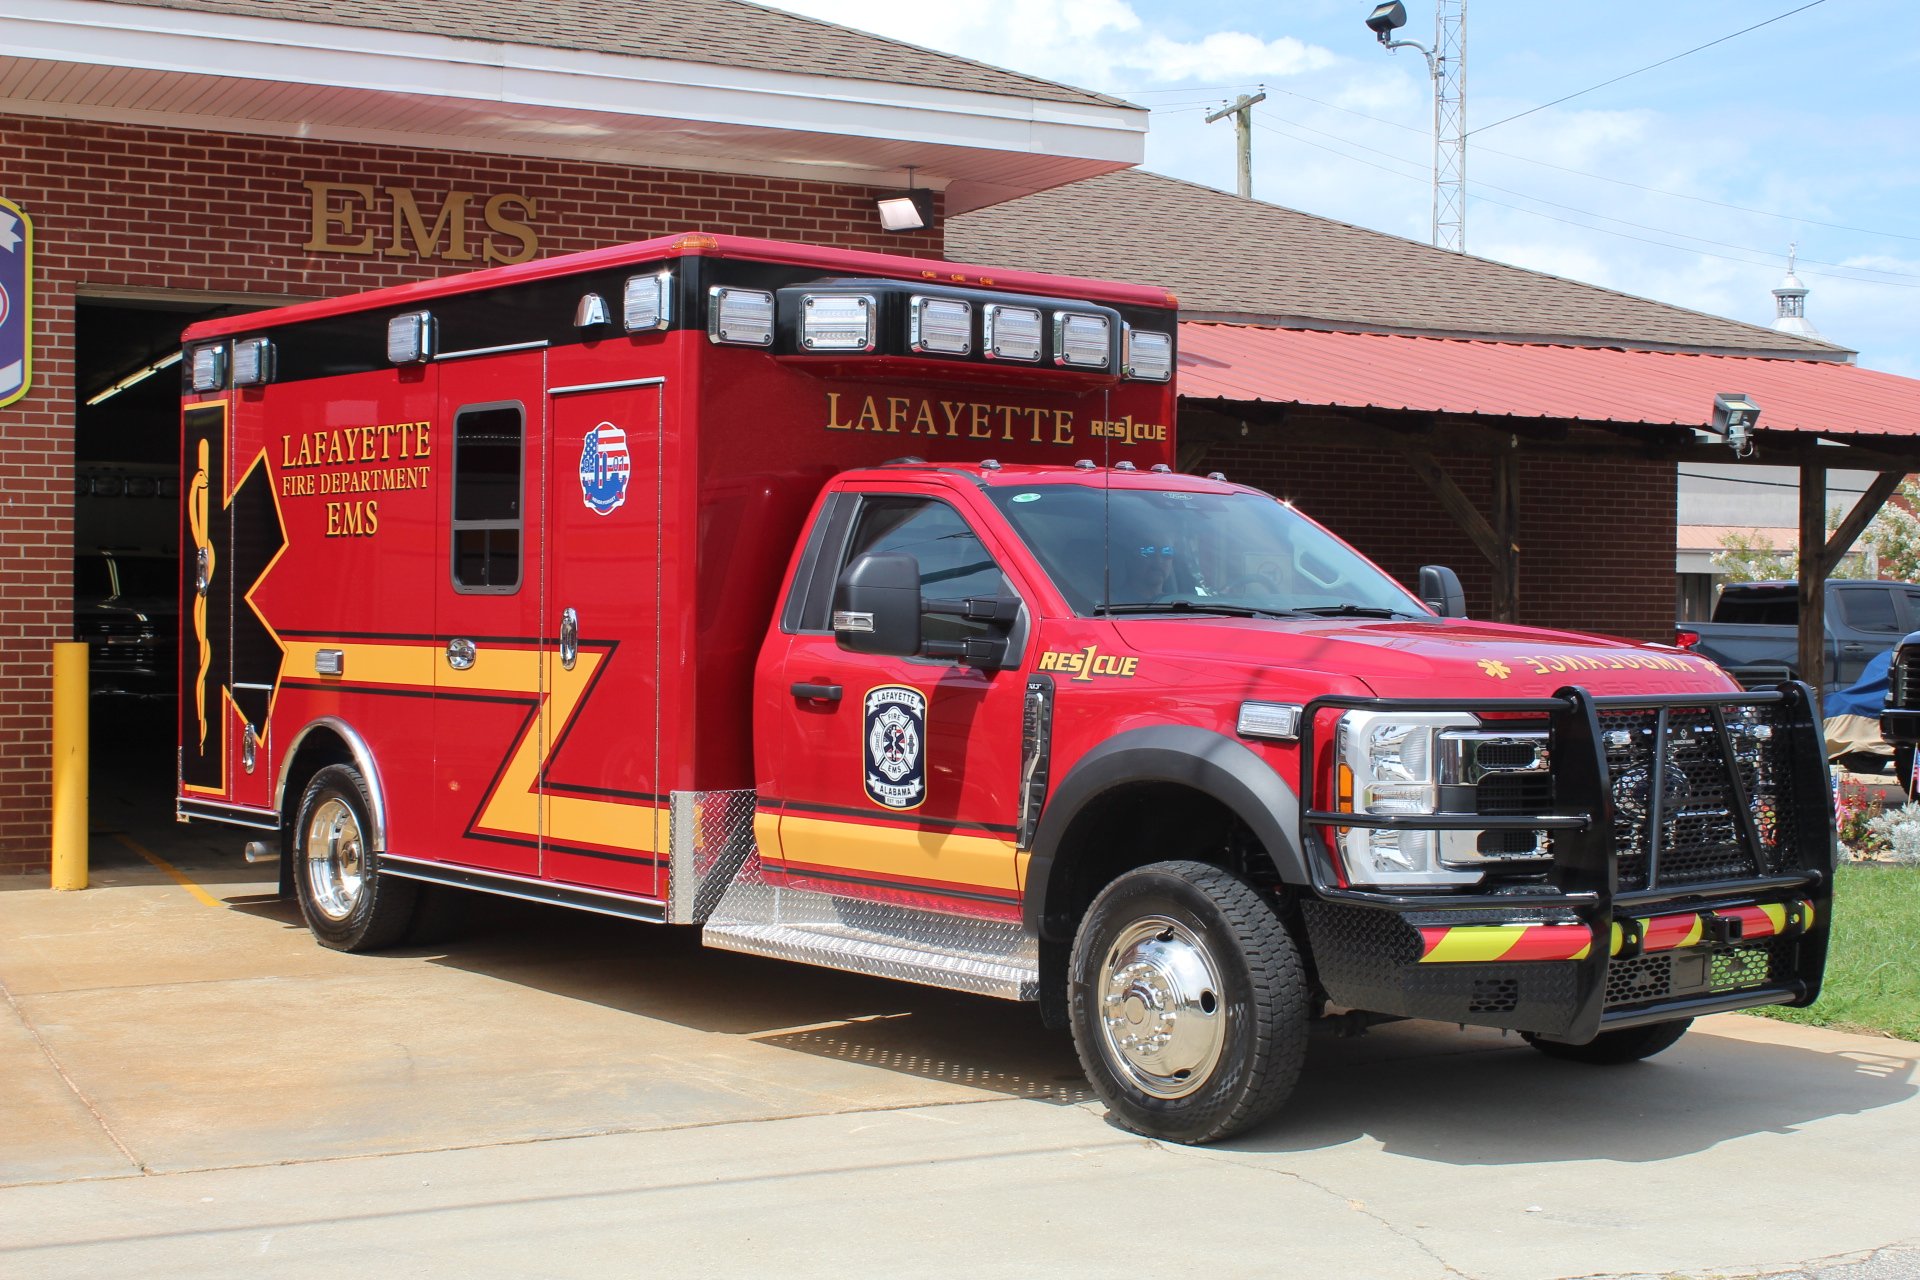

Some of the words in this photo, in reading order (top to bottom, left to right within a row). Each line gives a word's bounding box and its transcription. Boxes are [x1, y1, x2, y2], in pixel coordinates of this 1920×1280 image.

[303, 181, 538, 264] EMS
[827, 392, 1075, 444] LAFAYETTE
[282, 421, 431, 467] LAFAYETTE
[282, 474, 315, 496] FIRE
[320, 466, 430, 494] DEPARTMENT
[326, 500, 378, 535] EMS
[877, 691, 915, 705] LAFAYETTE
[887, 713, 900, 721] FIRE
[887, 765, 902, 774] EMS
[880, 785, 911, 797] ALABAMA
